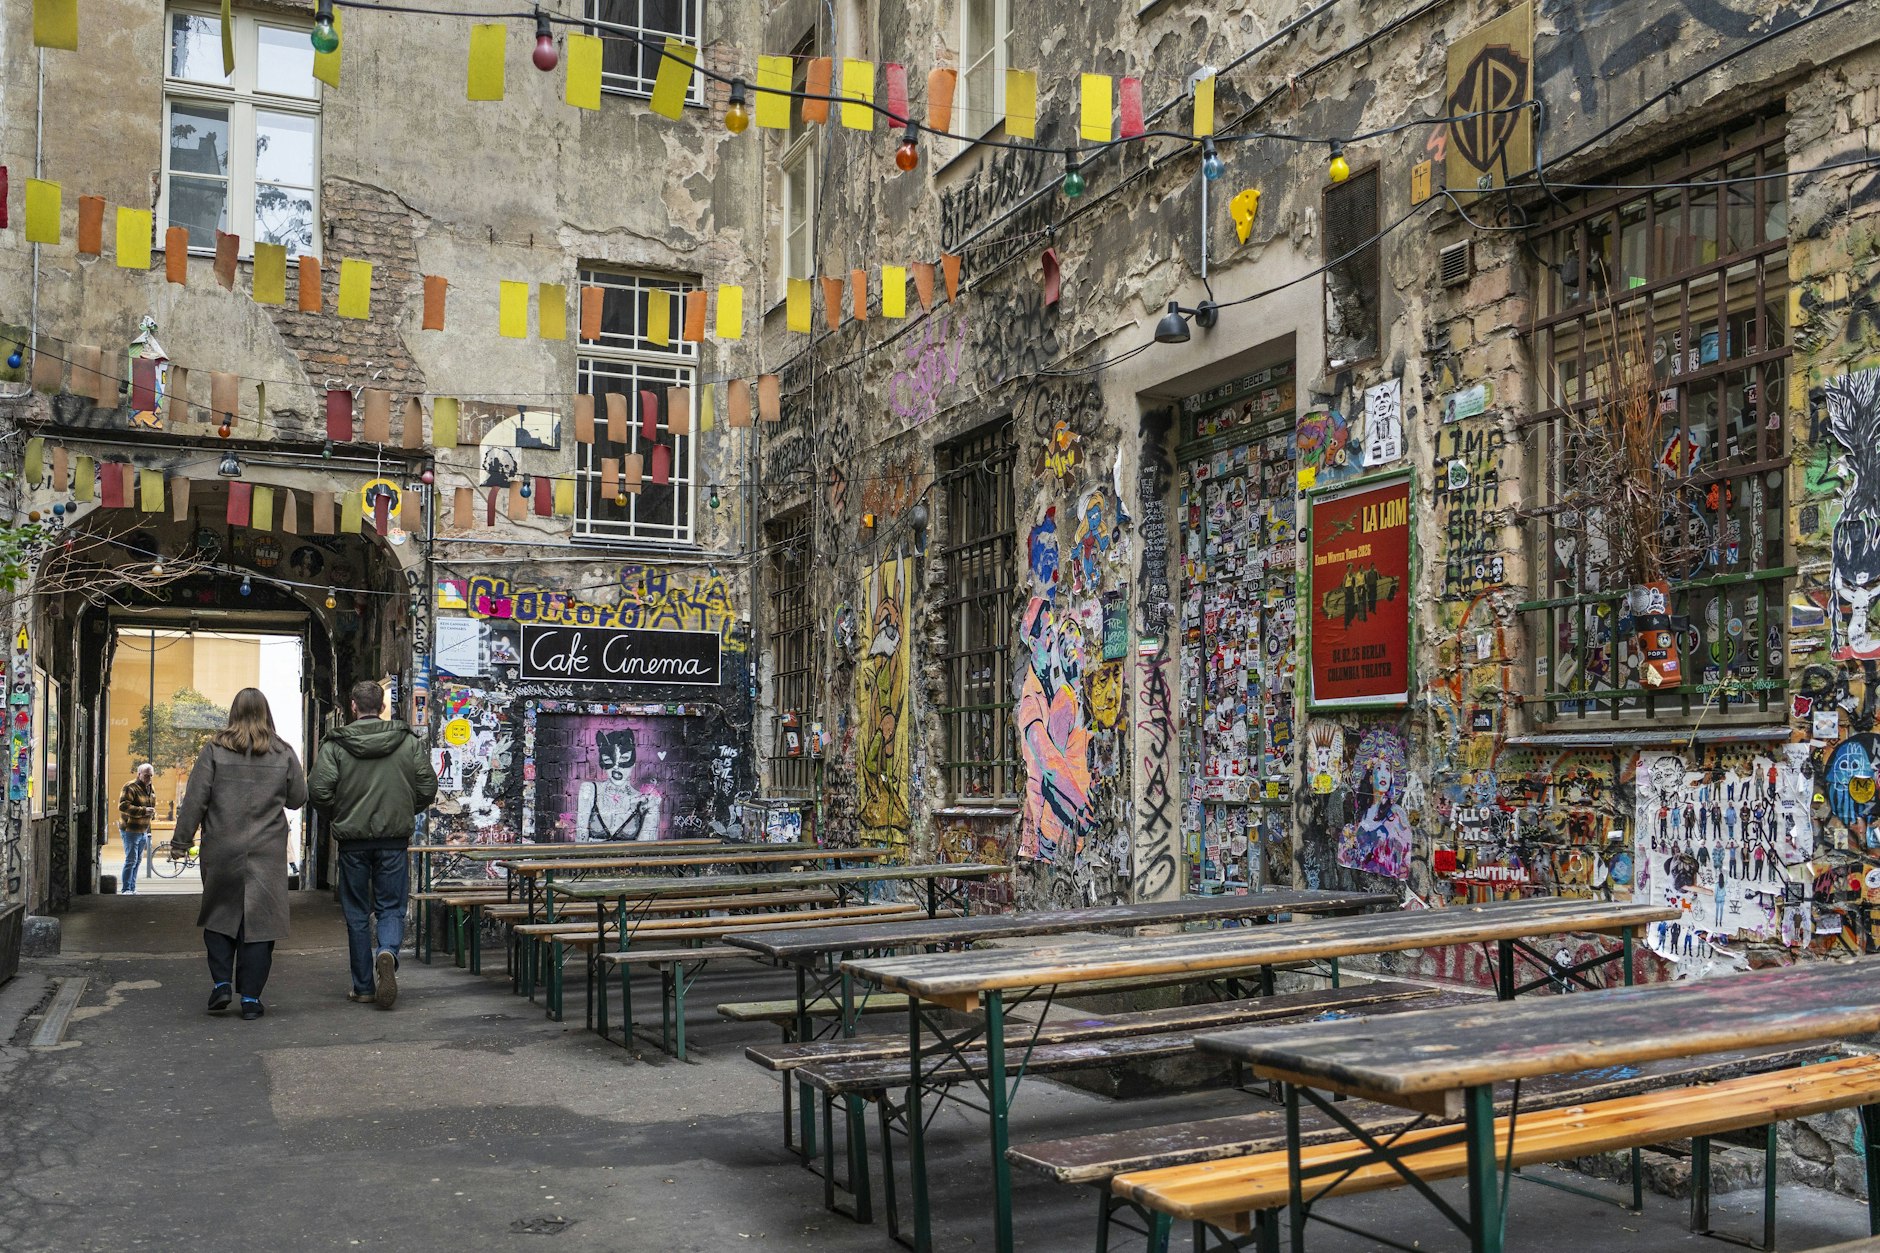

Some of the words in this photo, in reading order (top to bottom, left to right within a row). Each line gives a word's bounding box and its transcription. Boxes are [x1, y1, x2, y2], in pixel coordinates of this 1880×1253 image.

[1362, 504, 1378, 534] LA
[1379, 497, 1407, 530] LOM
[1357, 544, 1372, 557] 2026
[529, 630, 591, 676] Café
[602, 634, 711, 676] Cinema
[1332, 646, 1360, 664] 04.02.26
[1361, 643, 1386, 660] BERLIN
[1327, 665, 1360, 682] COLUMBIA
[1361, 662, 1392, 679] THEATER
[719, 745, 738, 758] THIS
[723, 758, 732, 767] IS
